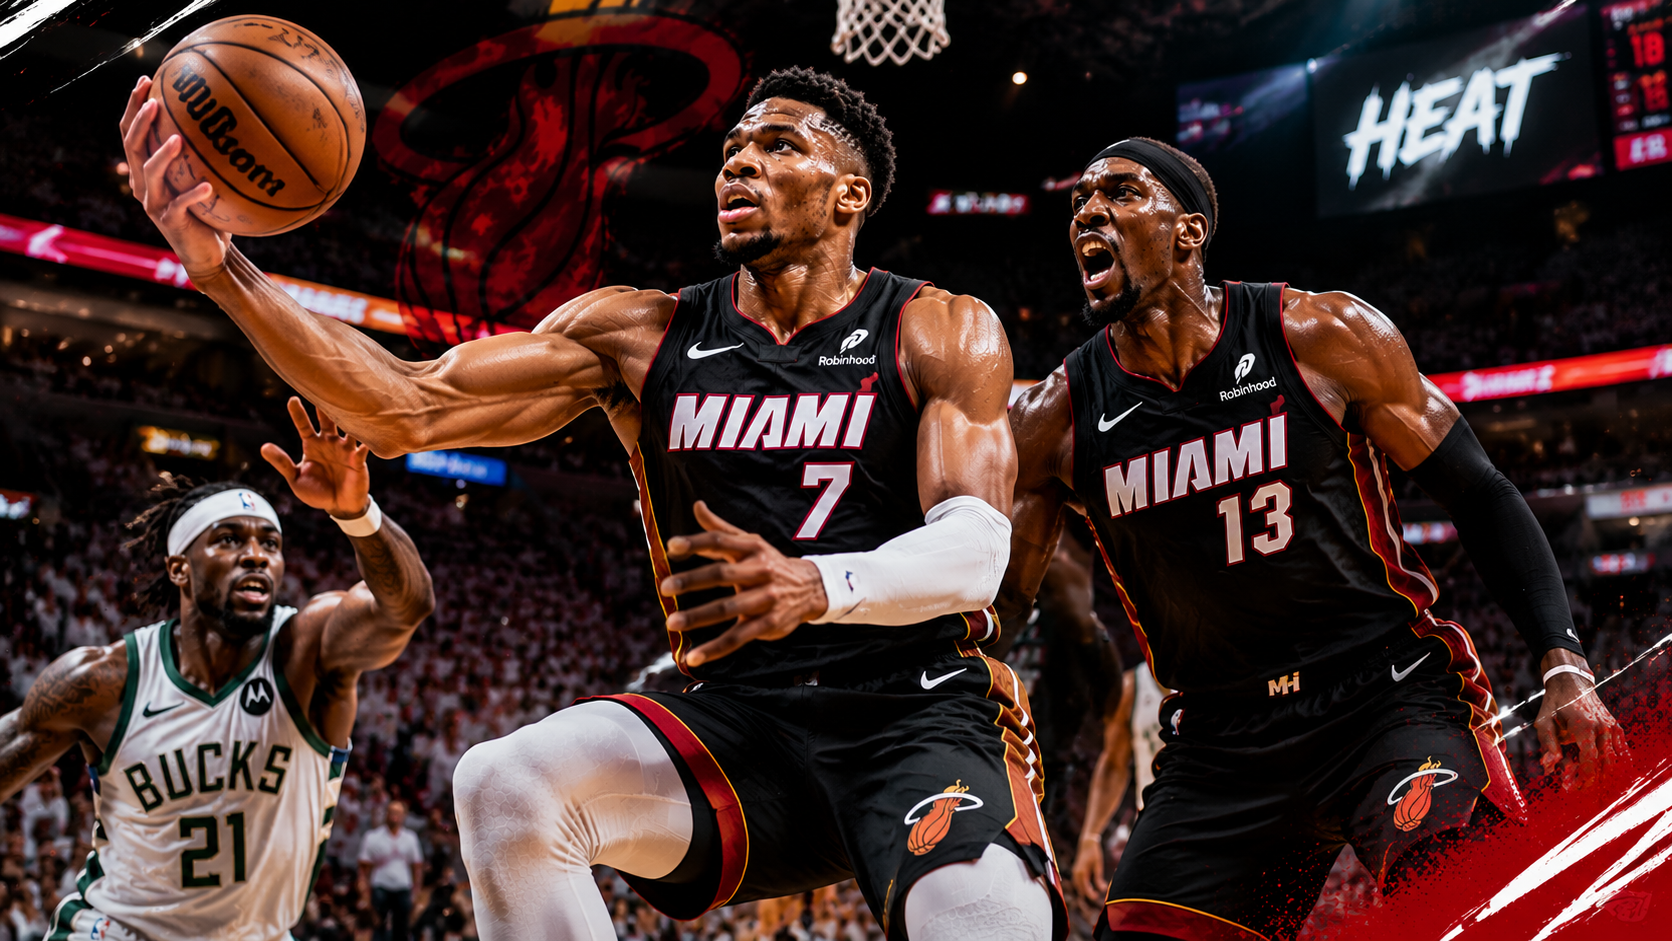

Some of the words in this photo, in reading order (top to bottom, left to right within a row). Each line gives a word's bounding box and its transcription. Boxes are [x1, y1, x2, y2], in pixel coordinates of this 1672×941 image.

[1343, 51, 1568, 190] HEAT
[818, 354, 877, 366] Robinhood
[1219, 376, 1277, 402] Robinhood
[667, 392, 878, 452] MIAMI
[792, 461, 855, 540] 7
[1102, 411, 1288, 519] MIAMI
[1216, 479, 1295, 567] 13
[124, 740, 292, 812] BUCKS
[179, 812, 246, 888] 21
